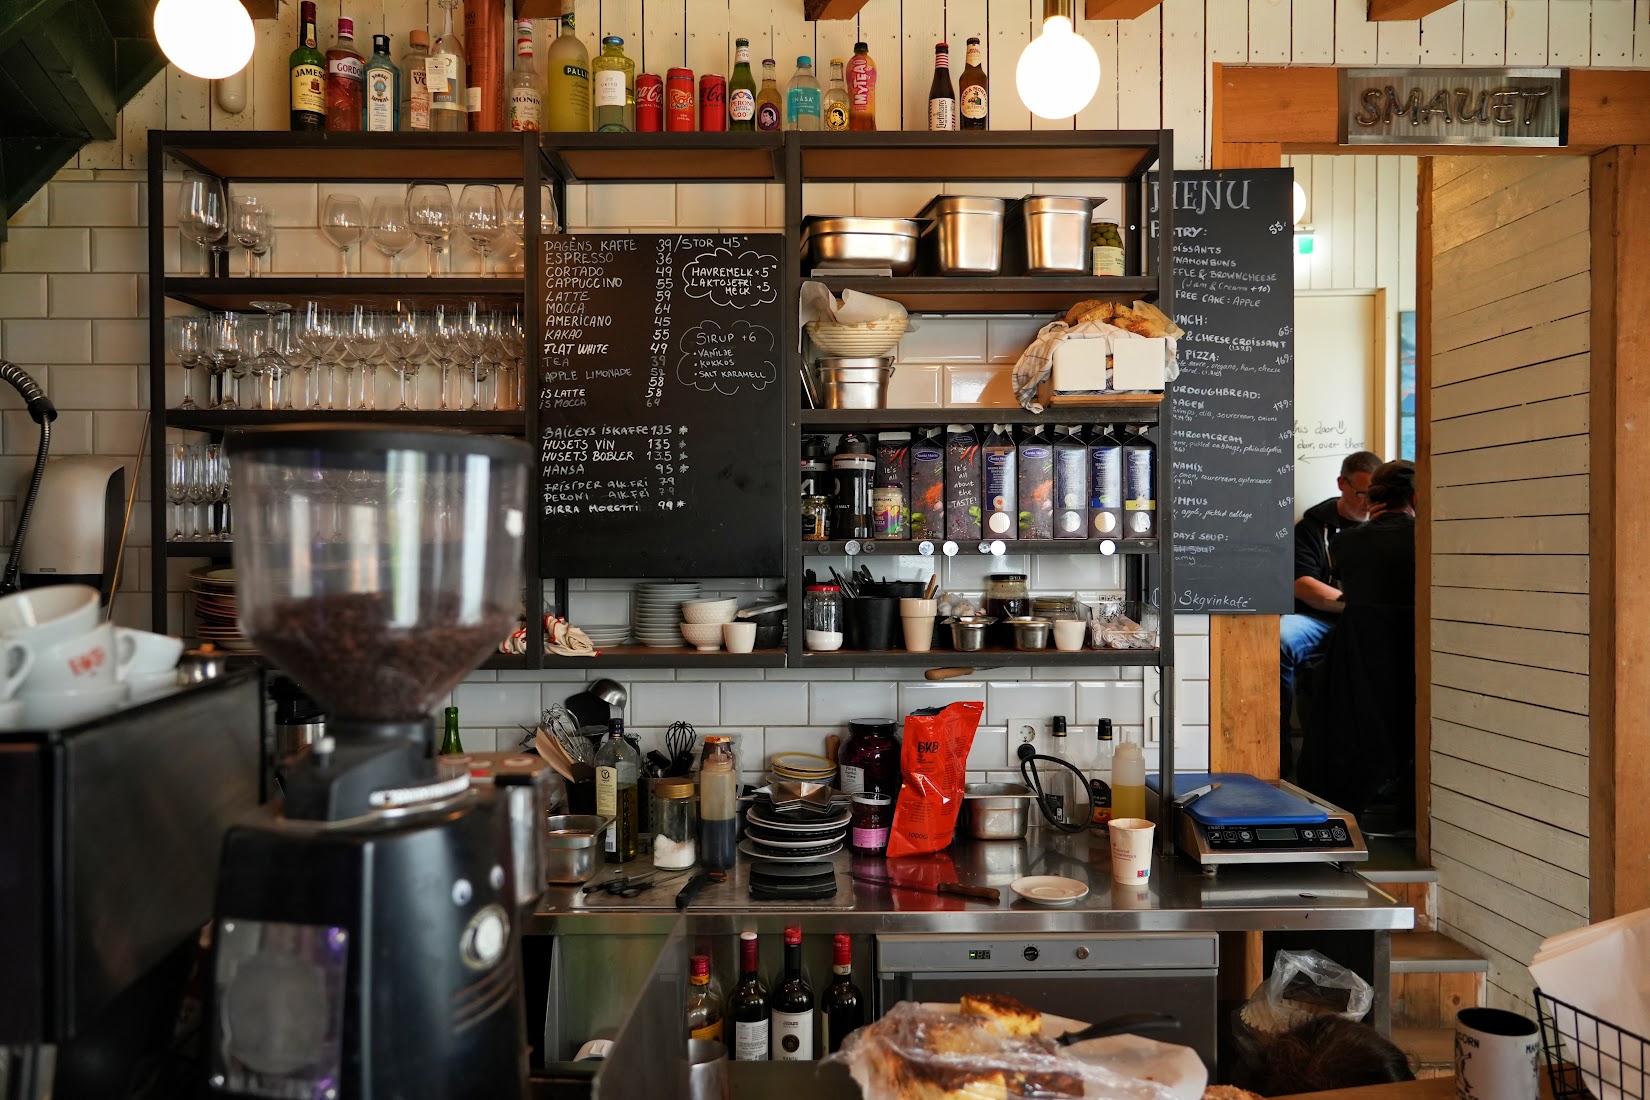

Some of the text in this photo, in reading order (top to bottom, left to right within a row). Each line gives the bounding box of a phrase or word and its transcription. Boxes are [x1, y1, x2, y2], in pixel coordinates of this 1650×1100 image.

[544, 240, 592, 251] DAGENS
[600, 239, 637, 250] KAFFE
[723, 237, 741, 248] 45
[1173, 243, 1221, 254] OISSANTS
[545, 253, 672, 265] ESPRESSO 36
[546, 266, 672, 277] CORTADO 49
[692, 267, 753, 277] HAVREMELK
[1173, 268, 1196, 277] FFLE
[546, 278, 674, 289] CAPPUCCINO 55
[546, 290, 671, 302] LATTE 59
[1176, 290, 1197, 300] FREE
[1233, 296, 1260, 307] APPLE
[546, 303, 670, 314] MOCCA 64
[654, 317, 671, 326] 45
[1173, 314, 1208, 325] UNCH:
[545, 330, 670, 340] KAKAO 55
[696, 333, 734, 344] SIRUP
[1195, 334, 1230, 344] CHEESE
[544, 344, 668, 355] FLAT WHITE 49
[652, 356, 666, 367] 39
[700, 359, 735, 367] KOKKOS
[545, 370, 577, 383] APPLE
[586, 368, 632, 380] LIMONADE
[699, 370, 766, 378] SALT KARAMELL
[648, 377, 665, 387] 58
[554, 388, 586, 397] LATTE
[645, 388, 662, 398] 58
[1173, 386, 1260, 399] URDOUGHBREAD:
[554, 399, 586, 408] MOCCA
[647, 398, 660, 408] 64
[650, 425, 672, 436] 135
[1173, 430, 1243, 444] SHROOMCREAM
[543, 439, 588, 450] HUSETS
[648, 439, 670, 450] 135
[542, 451, 588, 462] HUSETS
[592, 451, 634, 462] BOBLER
[542, 464, 673, 477] HANSA 95
[659, 477, 675, 486] 79
[543, 494, 589, 502] PERONI
[544, 505, 580, 515] BIRRA
[658, 500, 674, 510] 99
